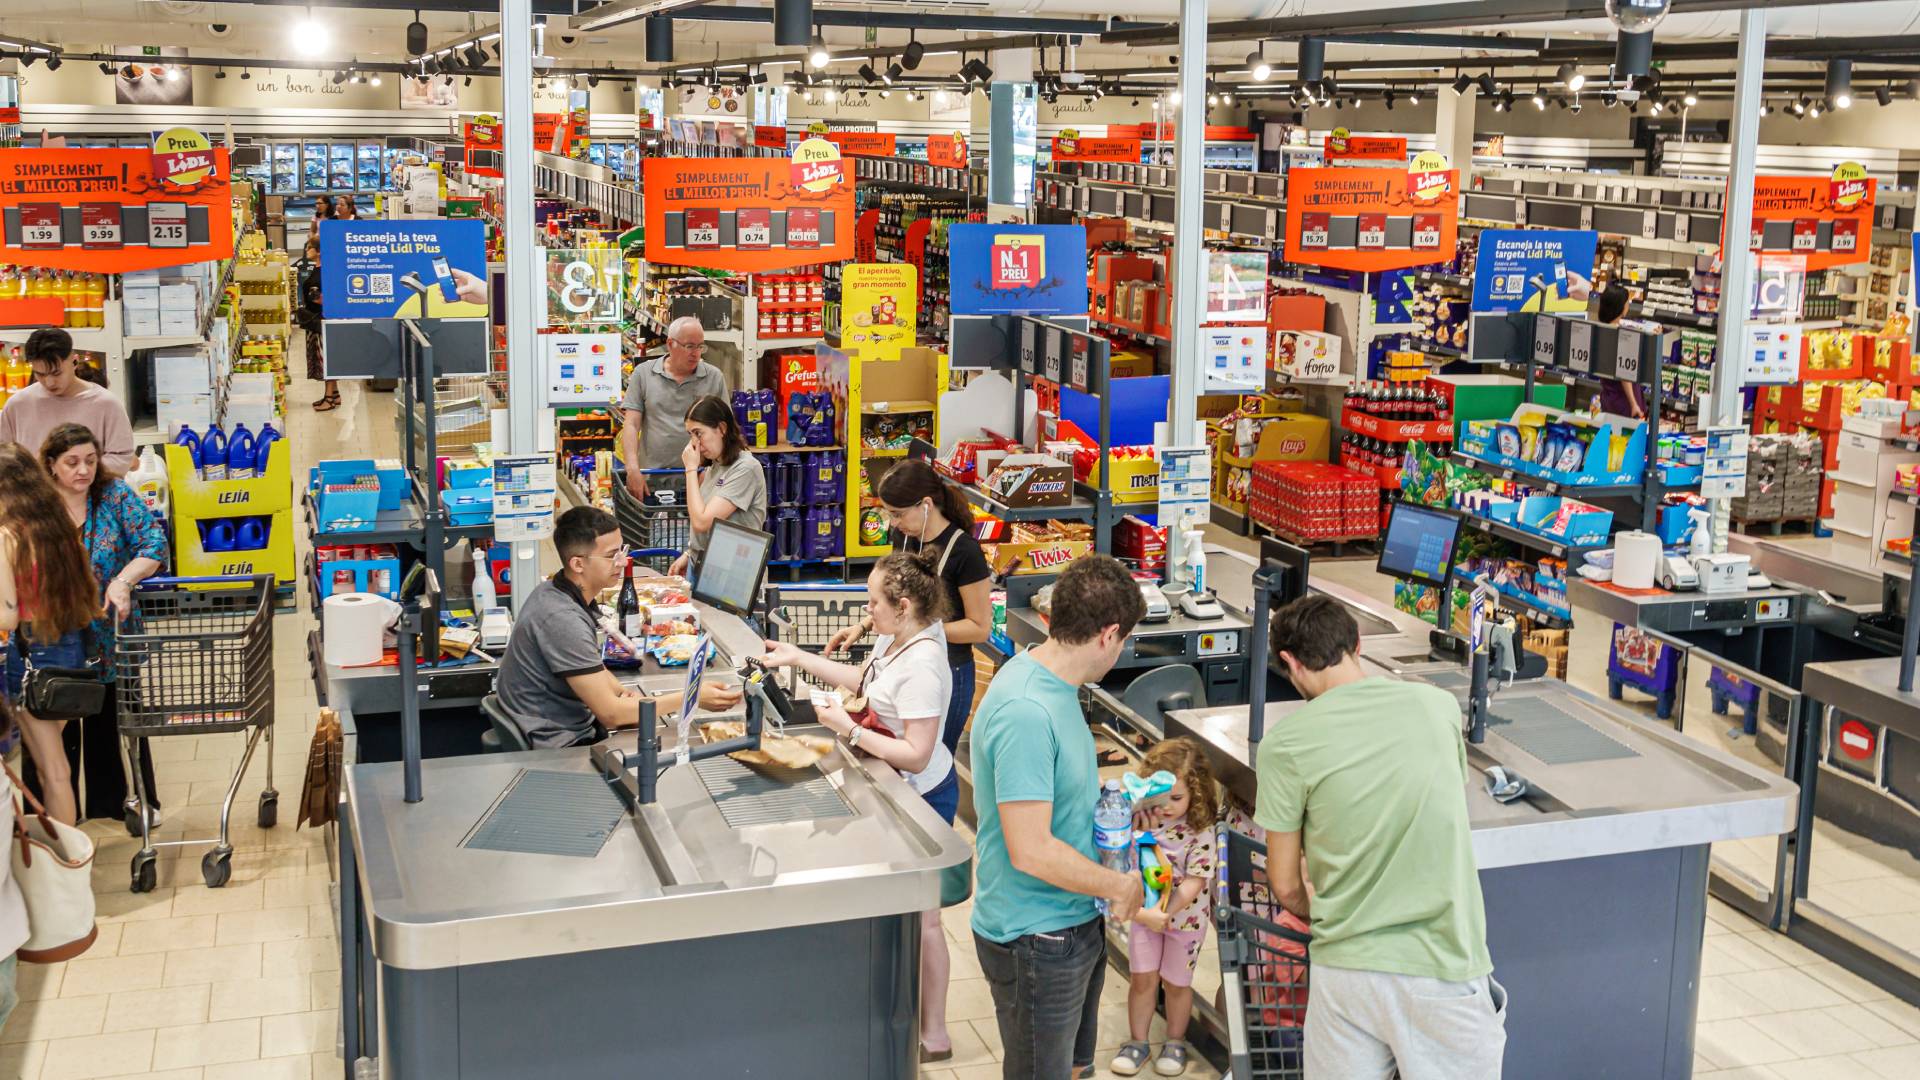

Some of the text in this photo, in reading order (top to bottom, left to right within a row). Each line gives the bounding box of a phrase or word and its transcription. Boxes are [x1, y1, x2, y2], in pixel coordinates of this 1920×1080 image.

[257, 82, 278, 92] un
[286, 74, 314, 94] bon
[167, 137, 197, 150] Preu
[804, 148, 829, 160] Preu
[14, 164, 104, 176] SIMPLEMENT
[1419, 160, 1440, 169] Preu
[676, 172, 750, 184] SIMPLEMENT
[1841, 169, 1859, 178] Preu
[2, 180, 20, 193] EL
[23, 179, 79, 193] MILLOR
[80, 178, 118, 192] PREU
[1314, 181, 1374, 189] SIMPLEMENT
[665, 188, 680, 199] EL
[683, 186, 729, 199] MILLOR
[730, 185, 761, 198] PREU
[1319, 194, 1355, 204] MILLOR
[1356, 192, 1382, 203] PREU
[1754, 188, 1800, 197] IMPLEMENT
[31, 231, 53, 240] 1.99
[90, 230, 114, 239] 9.99
[153, 226, 183, 239] 2.15
[345, 232, 437, 244] Escaneja la teva
[694, 233, 712, 242] 7.45
[745, 233, 764, 242] 0.74
[1306, 235, 1324, 243] 15.75
[1419, 235, 1434, 243] 1.69
[345, 243, 441, 255] targeta Lidl Plus
[1496, 240, 1562, 251] Escaneja la teva
[1495, 250, 1563, 260] targeta Lidl Plus
[866, 267, 902, 276] aperitivo,
[1001, 269, 1028, 280] PREU
[852, 282, 870, 290] gran
[1536, 340, 1554, 355] 0.99
[1022, 348, 1033, 362] 1.30
[1571, 348, 1588, 362] 1.09
[1047, 356, 1059, 371] 2.79
[1618, 356, 1637, 371] 1.09
[785, 370, 816, 384] Grefus
[1030, 481, 1065, 492] SNICKERS
[218, 488, 249, 504] LEJÍA
[1029, 547, 1073, 568] Twix
[222, 563, 253, 575] LEJÍA
